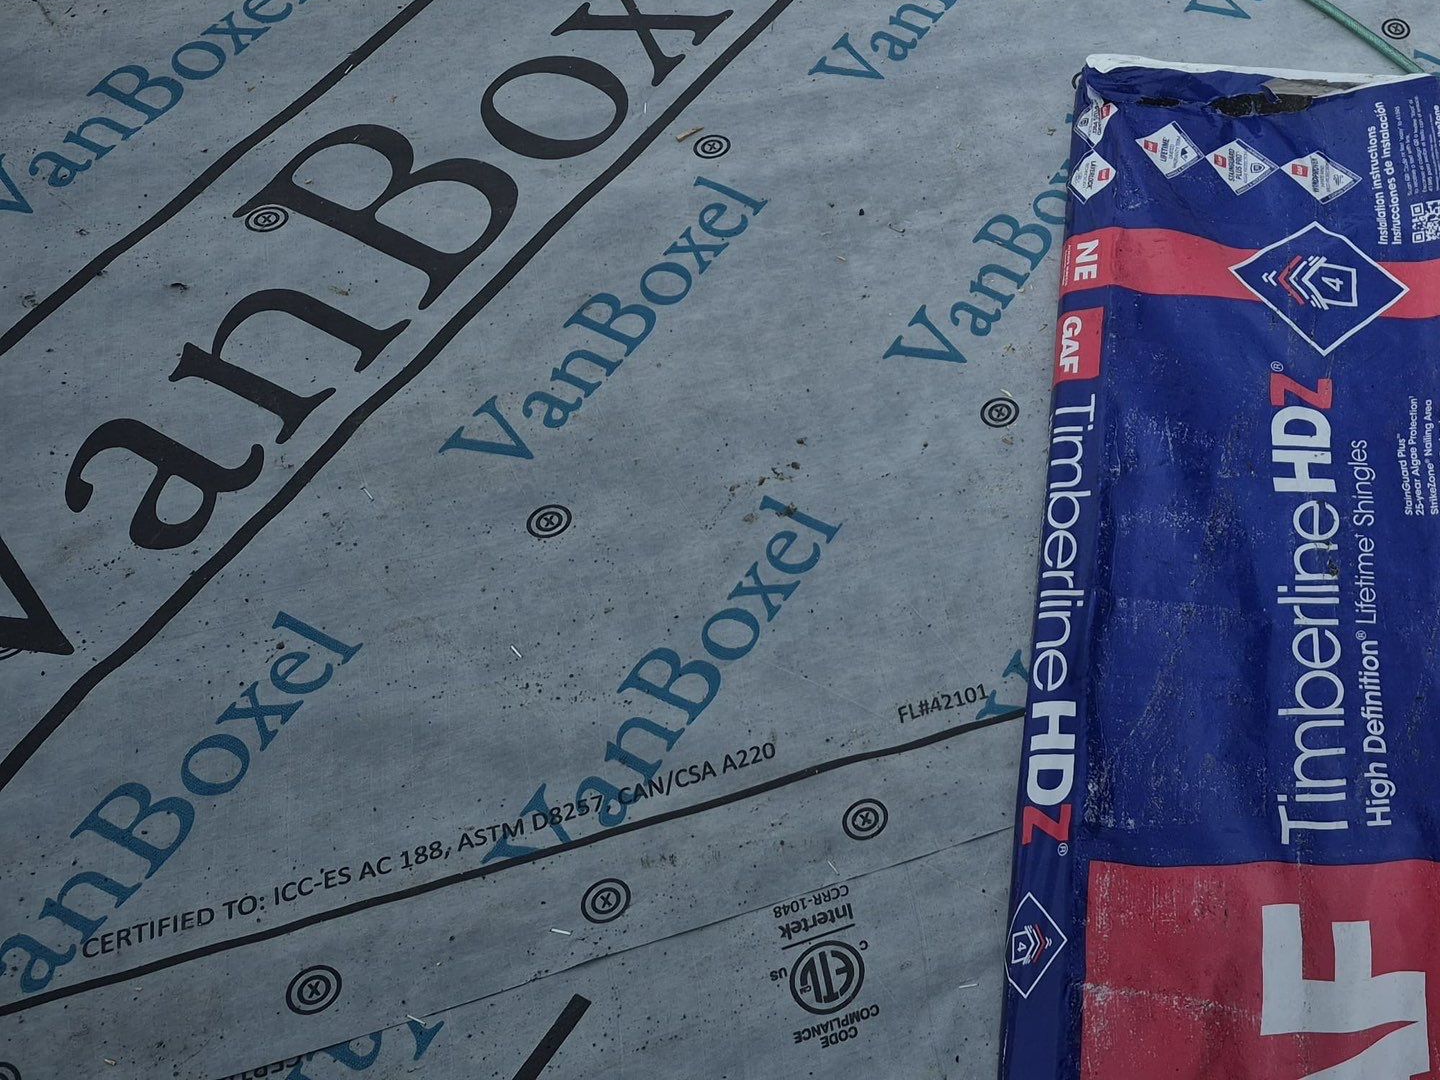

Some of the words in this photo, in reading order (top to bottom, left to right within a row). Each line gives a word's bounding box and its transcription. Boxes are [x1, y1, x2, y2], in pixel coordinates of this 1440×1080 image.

[1367, 126, 1382, 189] instructions
[1374, 101, 1391, 158] instalación
[1383, 160, 1395, 175] de
[1373, 191, 1389, 245] Installation
[1386, 177, 1402, 245] Instrucciones
[1074, 238, 1100, 283] NE
[439, 176, 769, 461] VanBoxel
[1059, 315, 1083, 375] GAF
[1423, 399, 1432, 421] Area
[1410, 446, 1421, 476] Algae
[1423, 423, 1434, 456] Nailing
[1347, 437, 1378, 527] Shingles
[1398, 460, 1413, 516] StainGuard
[1413, 478, 1425, 516] 25-year
[1032, 393, 1096, 692] Timberline
[482, 495, 844, 863] VanBoxel
[1277, 499, 1349, 846] Timberline
[897, 683, 990, 724] FL#42101
[0, 611, 364, 993] anBoxel
[1364, 749, 1398, 827] High
[82, 907, 215, 959] CERTIFIED
[222, 895, 266, 919] TO:
[273, 867, 353, 906] ICC-ES
[358, 857, 393, 881] AC
[400, 841, 453, 870] 188,
[457, 818, 525, 853] ASTM
[532, 795, 612, 831] D8257,
[617, 764, 718, 807] CAN/CSA
[722, 742, 777, 775] A220
[773, 883, 851, 921] CCRR-1048
[778, 902, 854, 941] Intertek
[793, 1003, 880, 1045] COMPLIANCE
[821, 1025, 859, 1050] CODE
